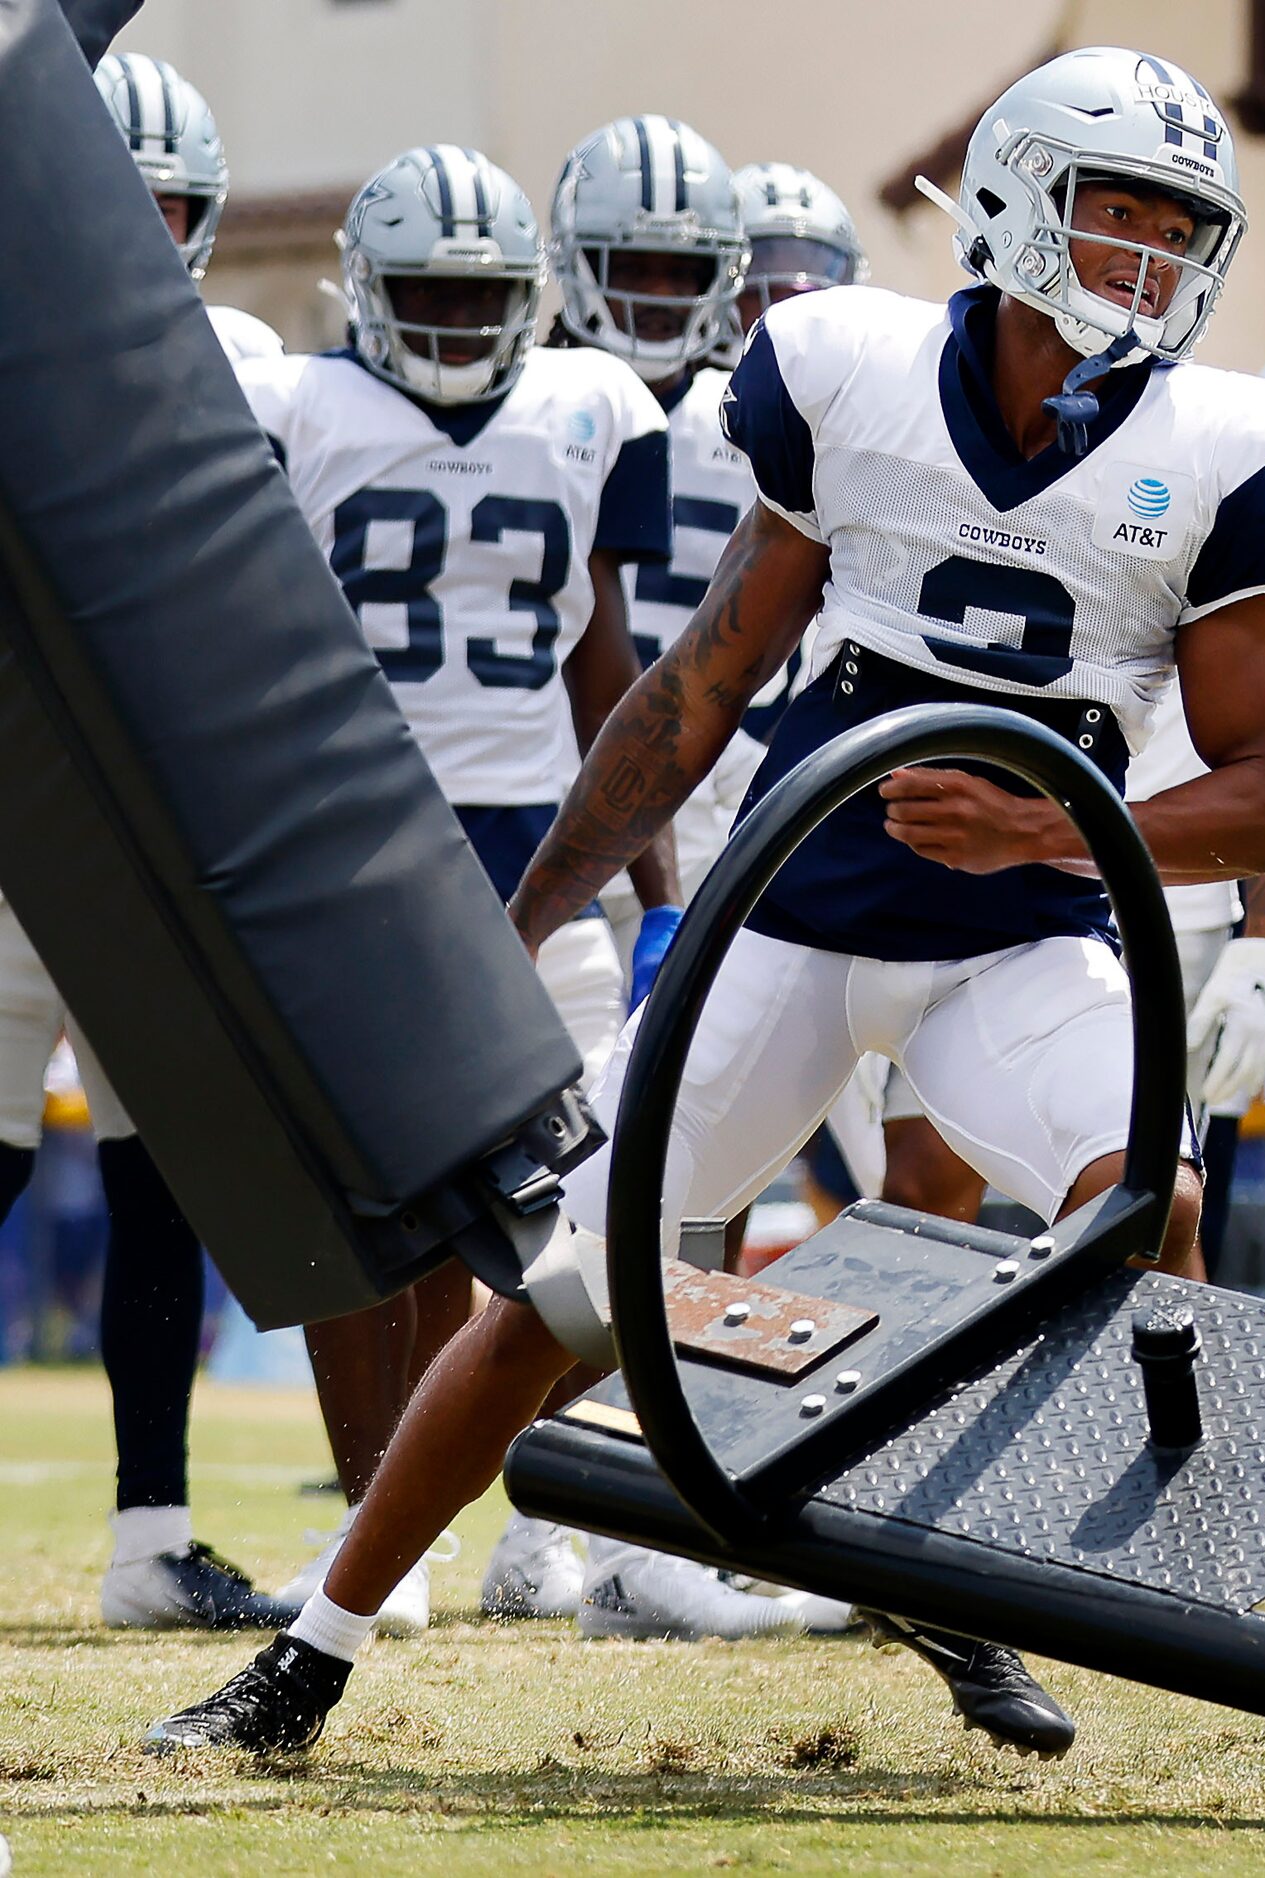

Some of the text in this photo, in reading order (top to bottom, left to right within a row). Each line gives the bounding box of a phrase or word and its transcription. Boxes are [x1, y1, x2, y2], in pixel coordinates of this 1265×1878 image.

[1171, 153, 1214, 177] COWBOYS
[959, 523, 1047, 554] COWBOYS
[1113, 523, 1168, 549] AT&T
[330, 488, 572, 690] 83
